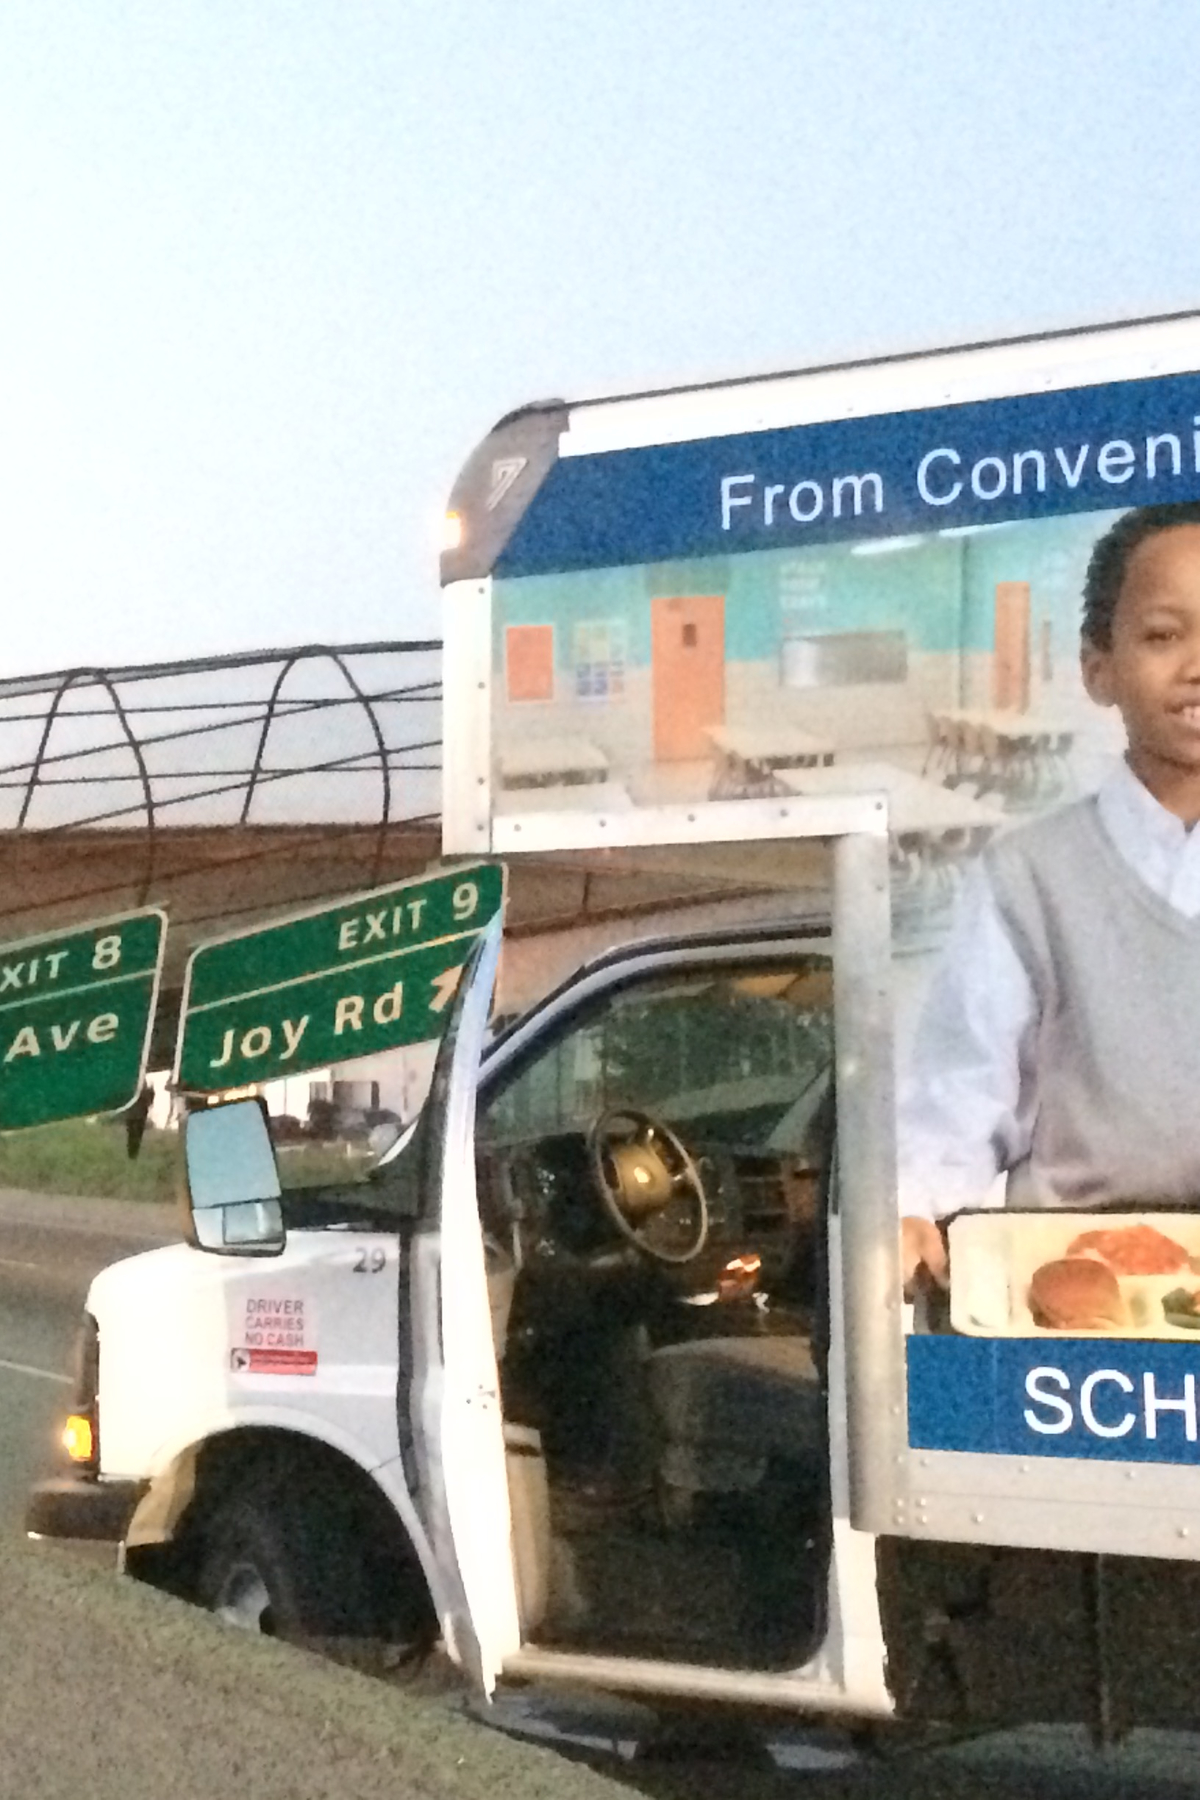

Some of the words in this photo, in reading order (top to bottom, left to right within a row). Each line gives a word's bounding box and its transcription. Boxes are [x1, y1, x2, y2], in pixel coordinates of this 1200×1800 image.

[719, 472, 885, 530] From
[338, 899, 428, 950] EXIT
[452, 882, 479, 921] 9
[92, 935, 122, 969] 8
[2, 1012, 120, 1063] Ave
[209, 1015, 311, 1068] Joy
[333, 981, 403, 1035] Rd
[353, 1246, 386, 1274] 29
[245, 1316, 304, 1331] CARRIES
[246, 1299, 304, 1315] DRIVER
[245, 1332, 263, 1346] NO
[267, 1333, 304, 1347] CASH
[1023, 1366, 1198, 1441] SCH
